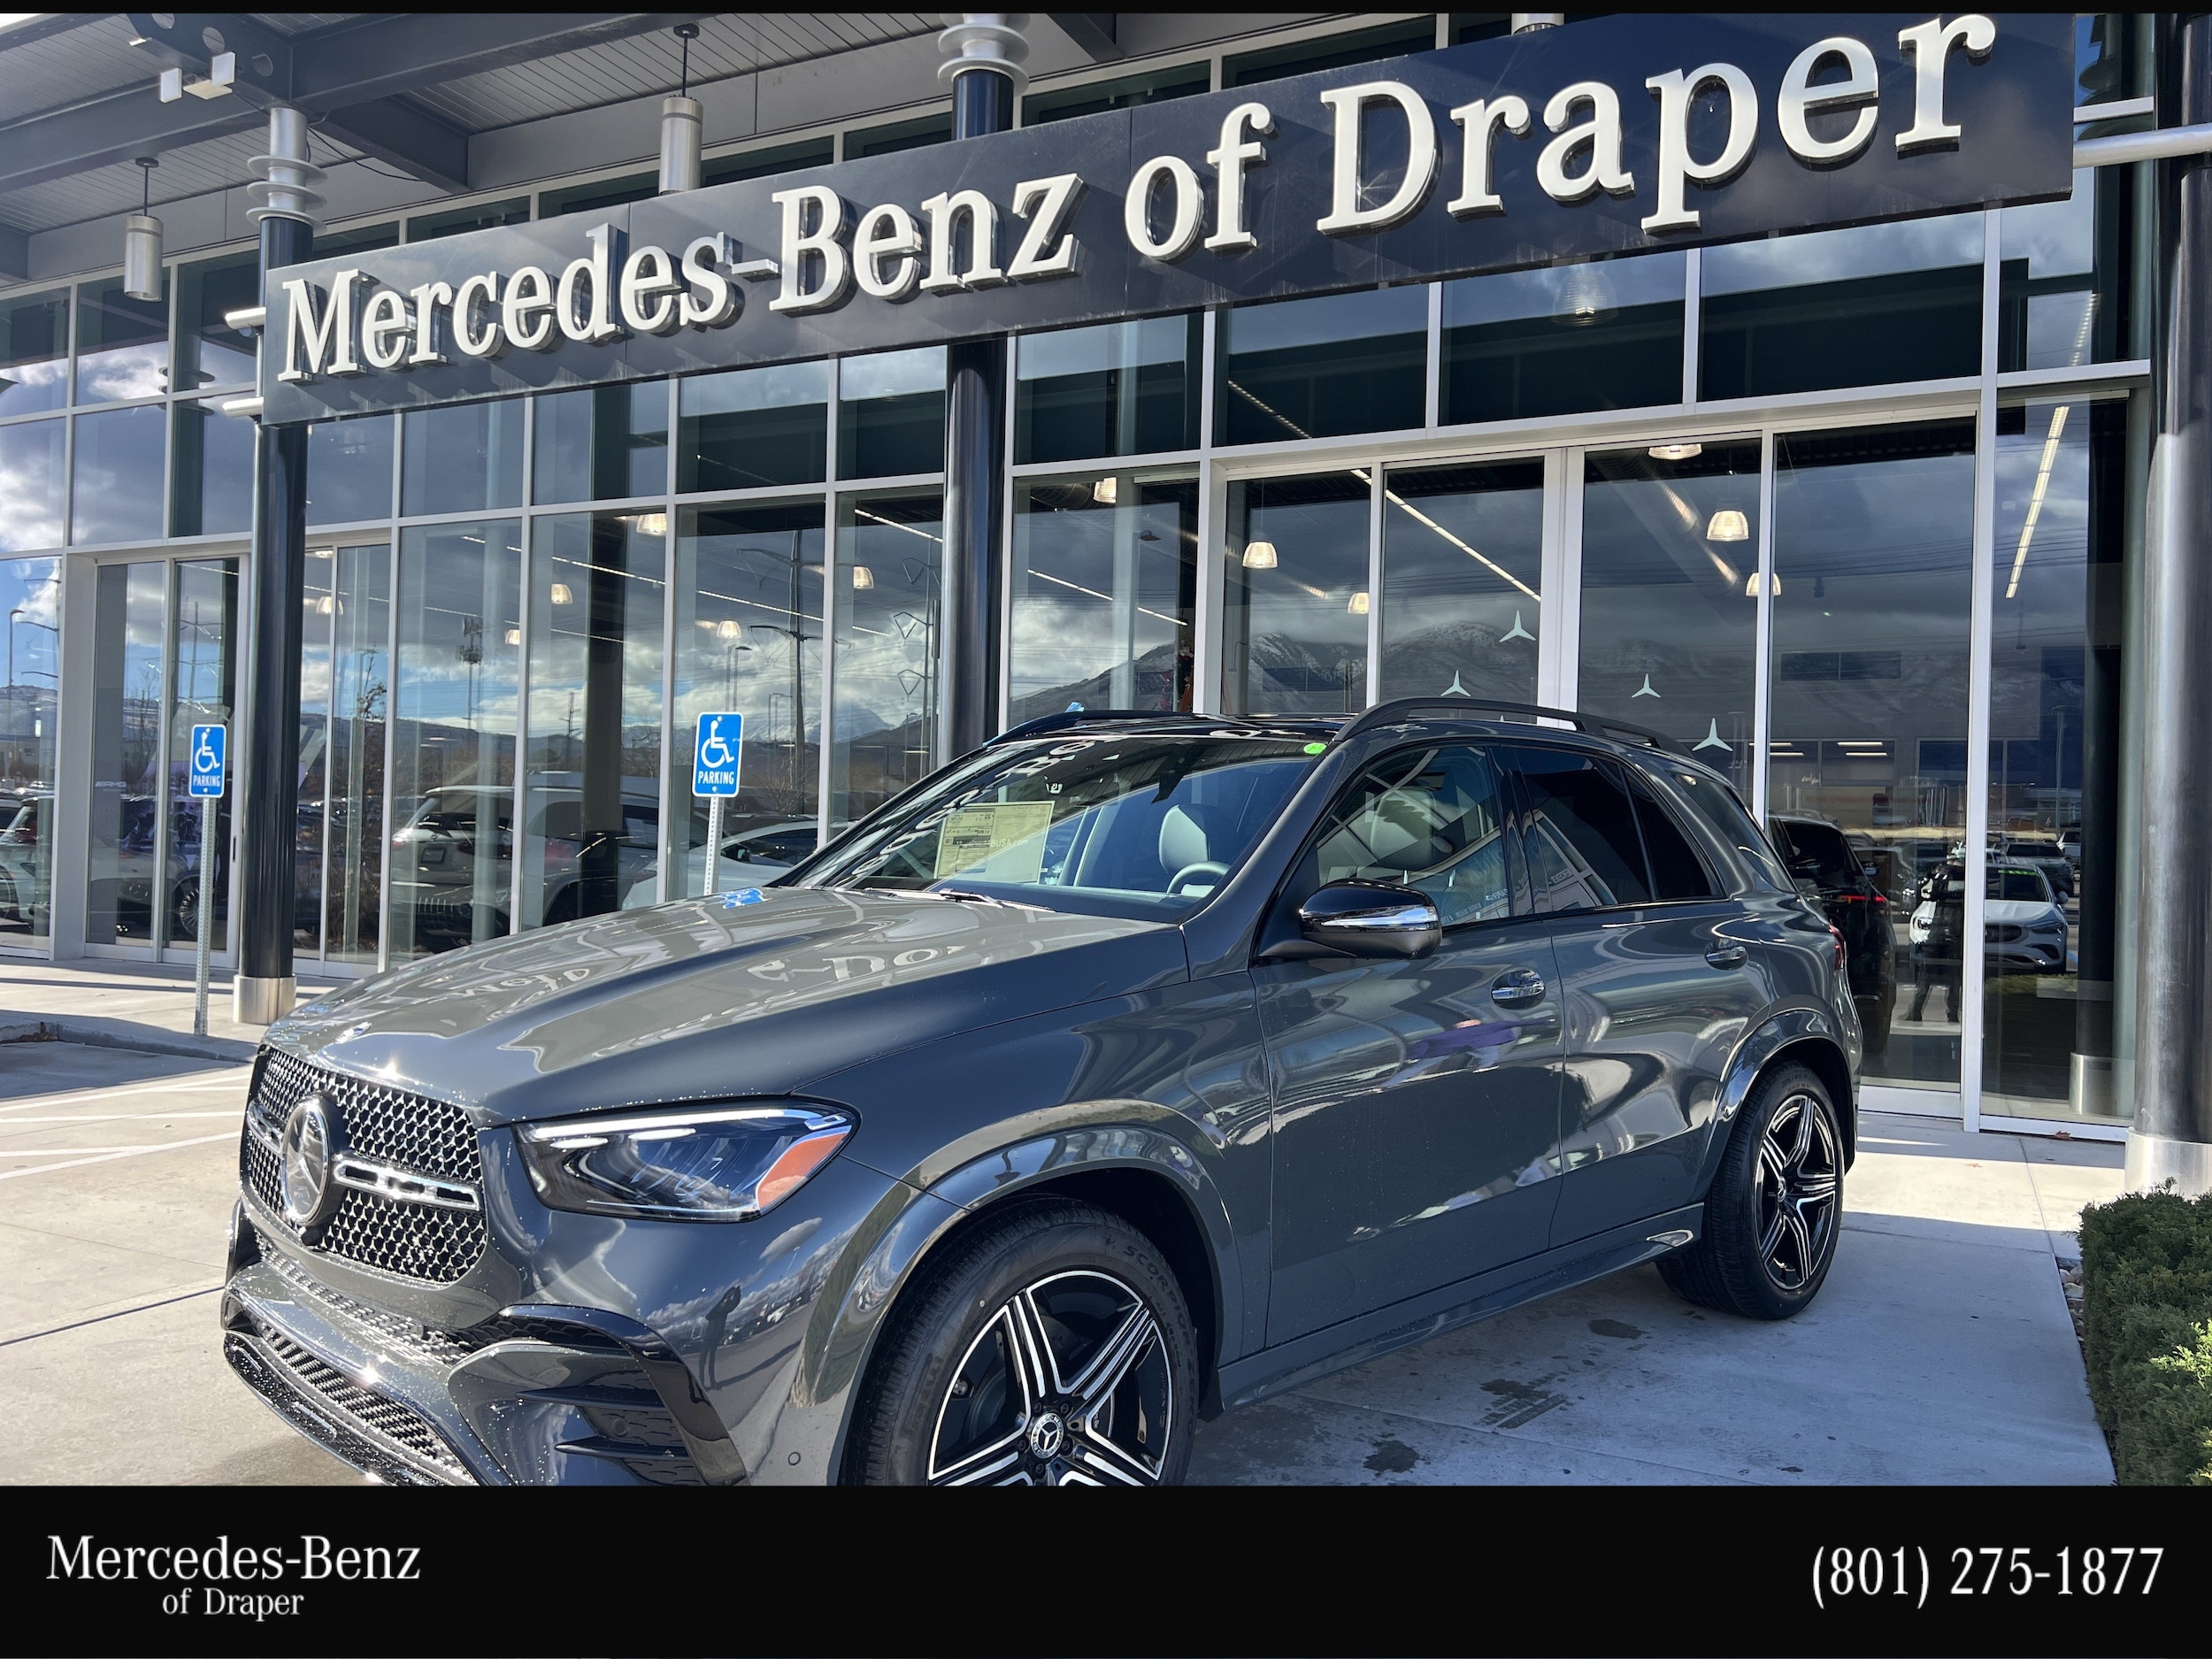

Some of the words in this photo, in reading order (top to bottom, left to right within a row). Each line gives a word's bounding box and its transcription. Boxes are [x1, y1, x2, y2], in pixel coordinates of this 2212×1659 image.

[277, 174, 1085, 384] Mercedes-Benz
[1125, 102, 1276, 262] of
[1316, 14, 1996, 234] Draper
[193, 774, 220, 787] PARKING
[697, 771, 734, 785] PARKING
[1123, 1244, 1192, 1346] SCORPION
